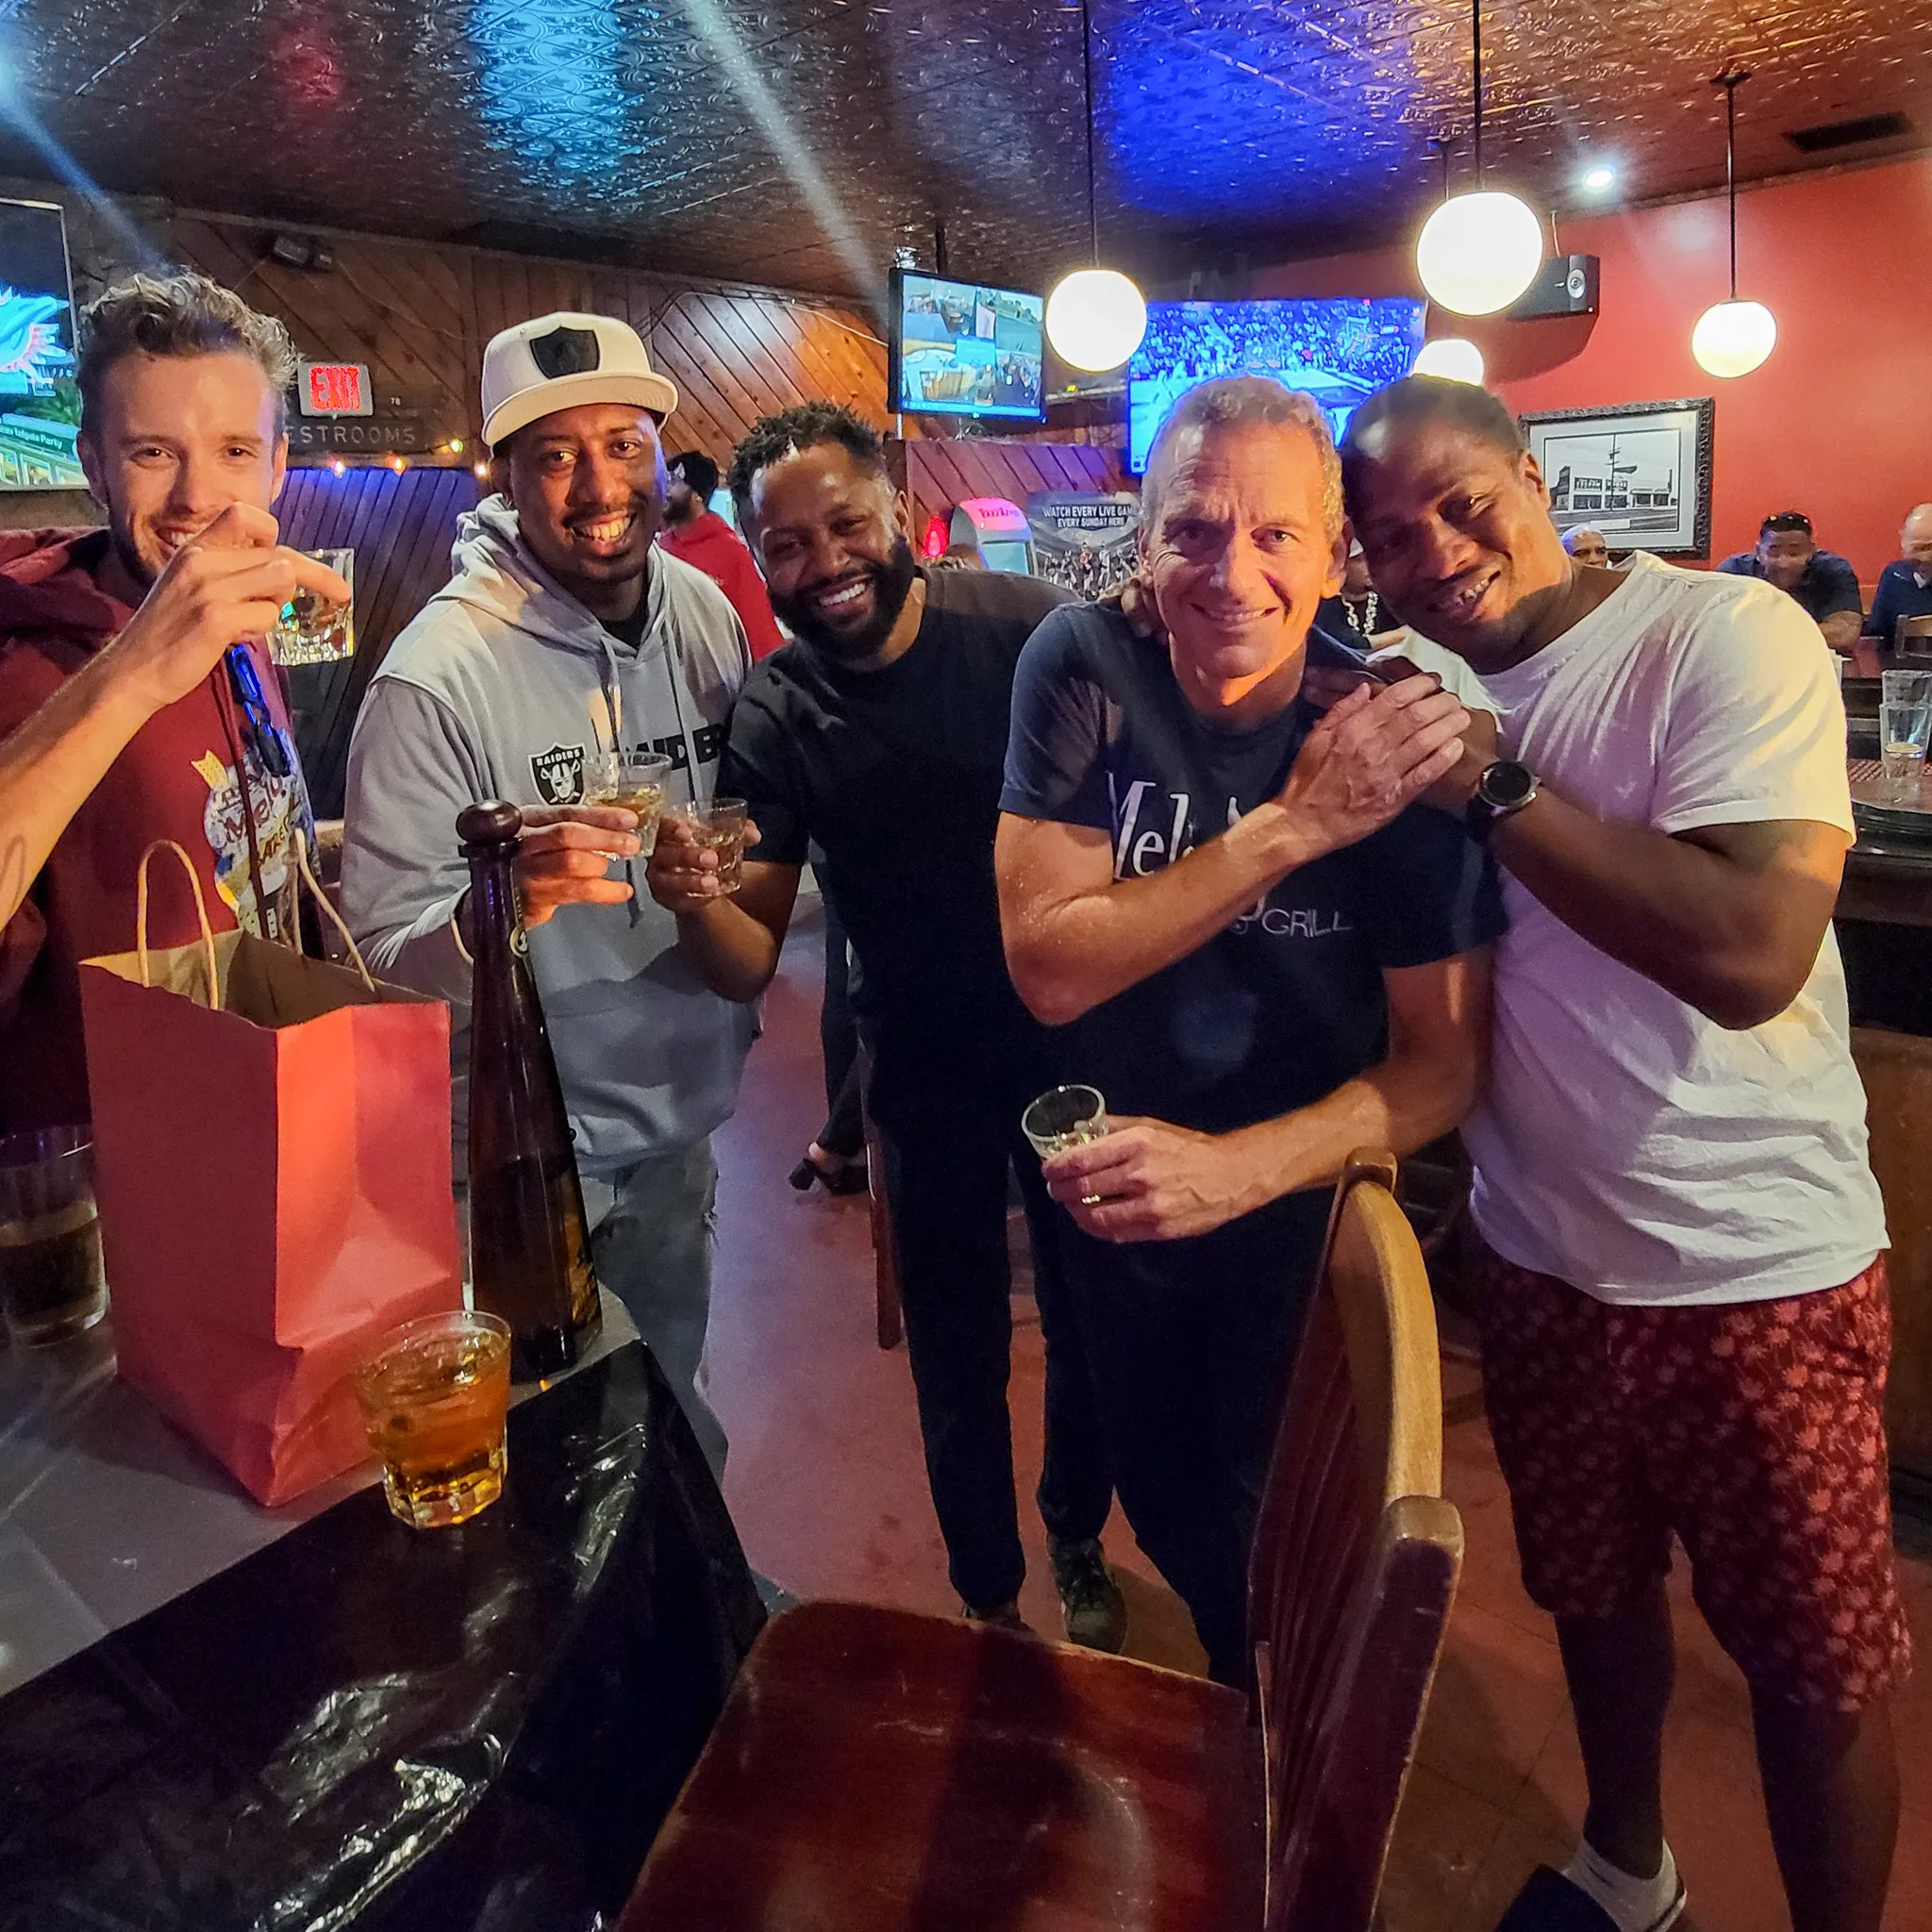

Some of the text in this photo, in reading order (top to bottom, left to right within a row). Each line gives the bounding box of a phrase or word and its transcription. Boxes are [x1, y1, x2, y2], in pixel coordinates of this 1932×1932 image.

[309, 364, 361, 411] EXIT
[285, 425, 416, 444] ESTROOMS
[1042, 506, 1071, 518] WATCH
[1072, 505, 1097, 517] EVERY
[1098, 505, 1116, 517] LIVE
[1058, 517, 1080, 528] EVERY
[1080, 517, 1108, 527] SUNDAY
[536, 748, 580, 767] RAIDERS
[1261, 908, 1353, 938] GRILL
